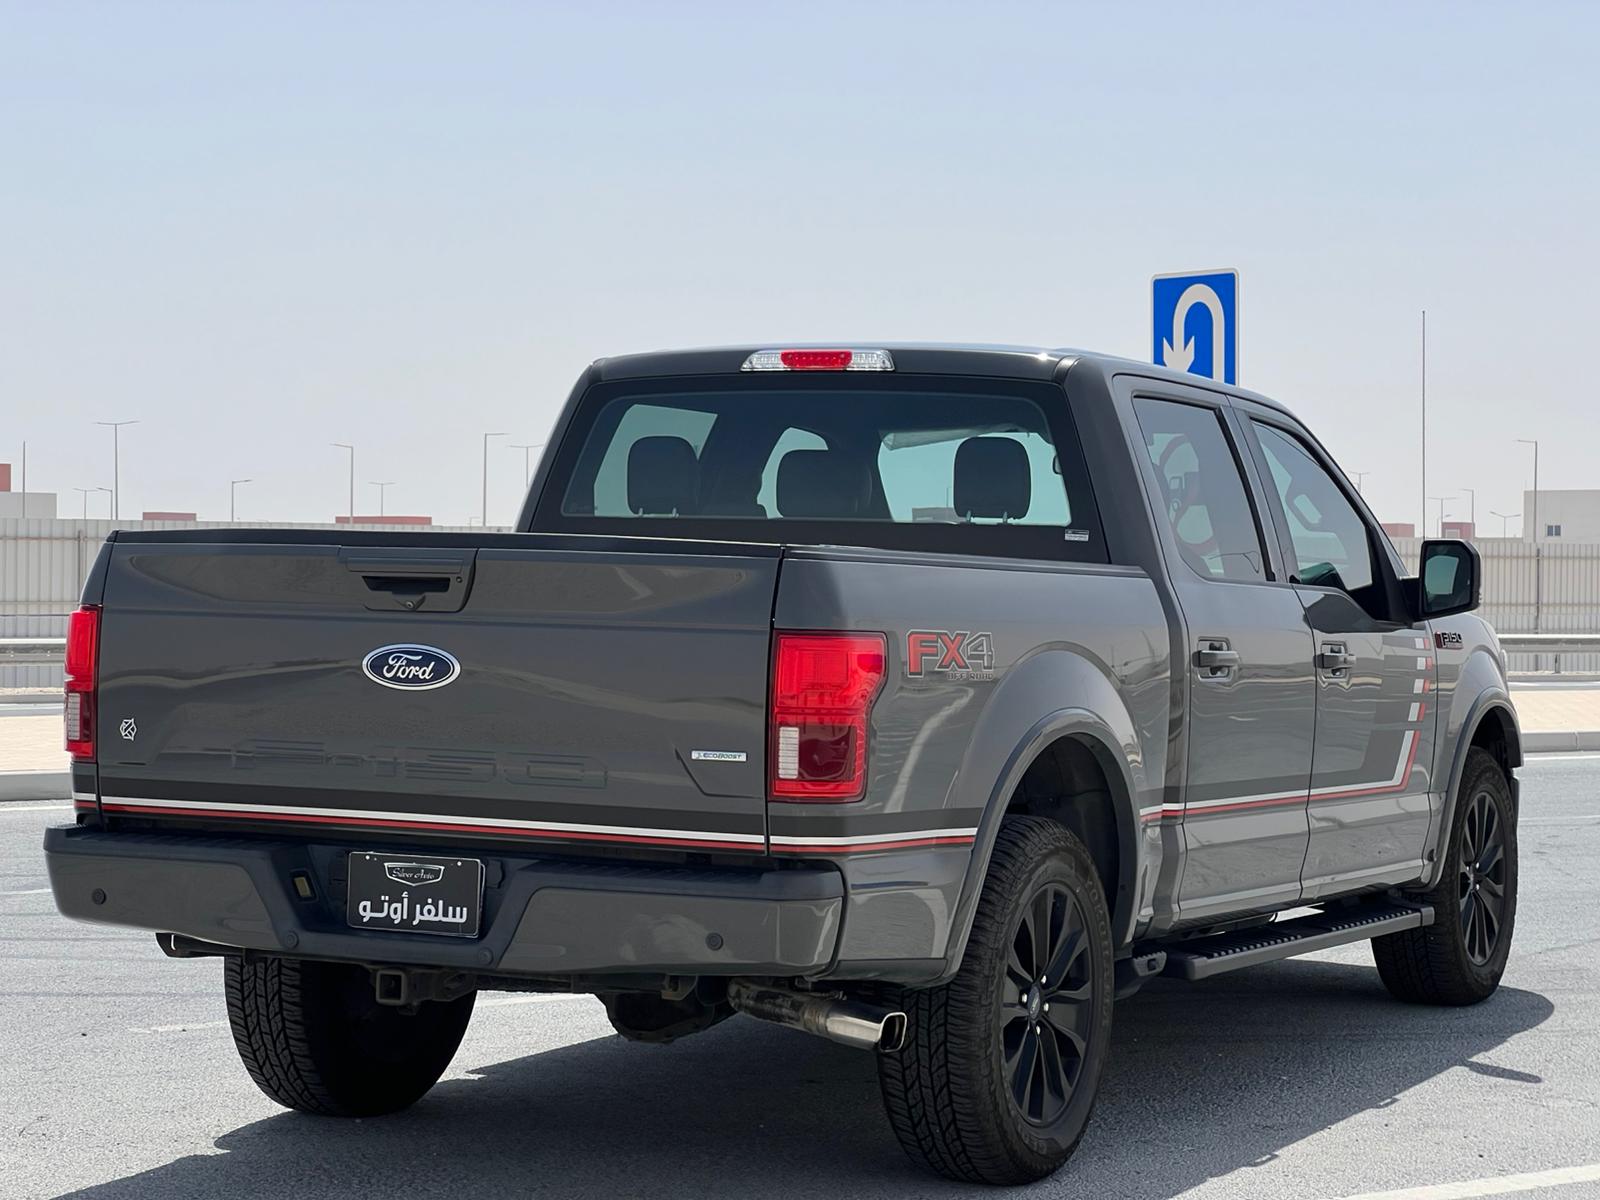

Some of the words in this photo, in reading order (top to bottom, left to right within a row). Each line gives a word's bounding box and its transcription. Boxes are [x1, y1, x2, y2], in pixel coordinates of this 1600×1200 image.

[382, 653, 436, 680] Ford
[906, 629, 994, 678] FX4
[412, 898, 468, 926] سلفر
